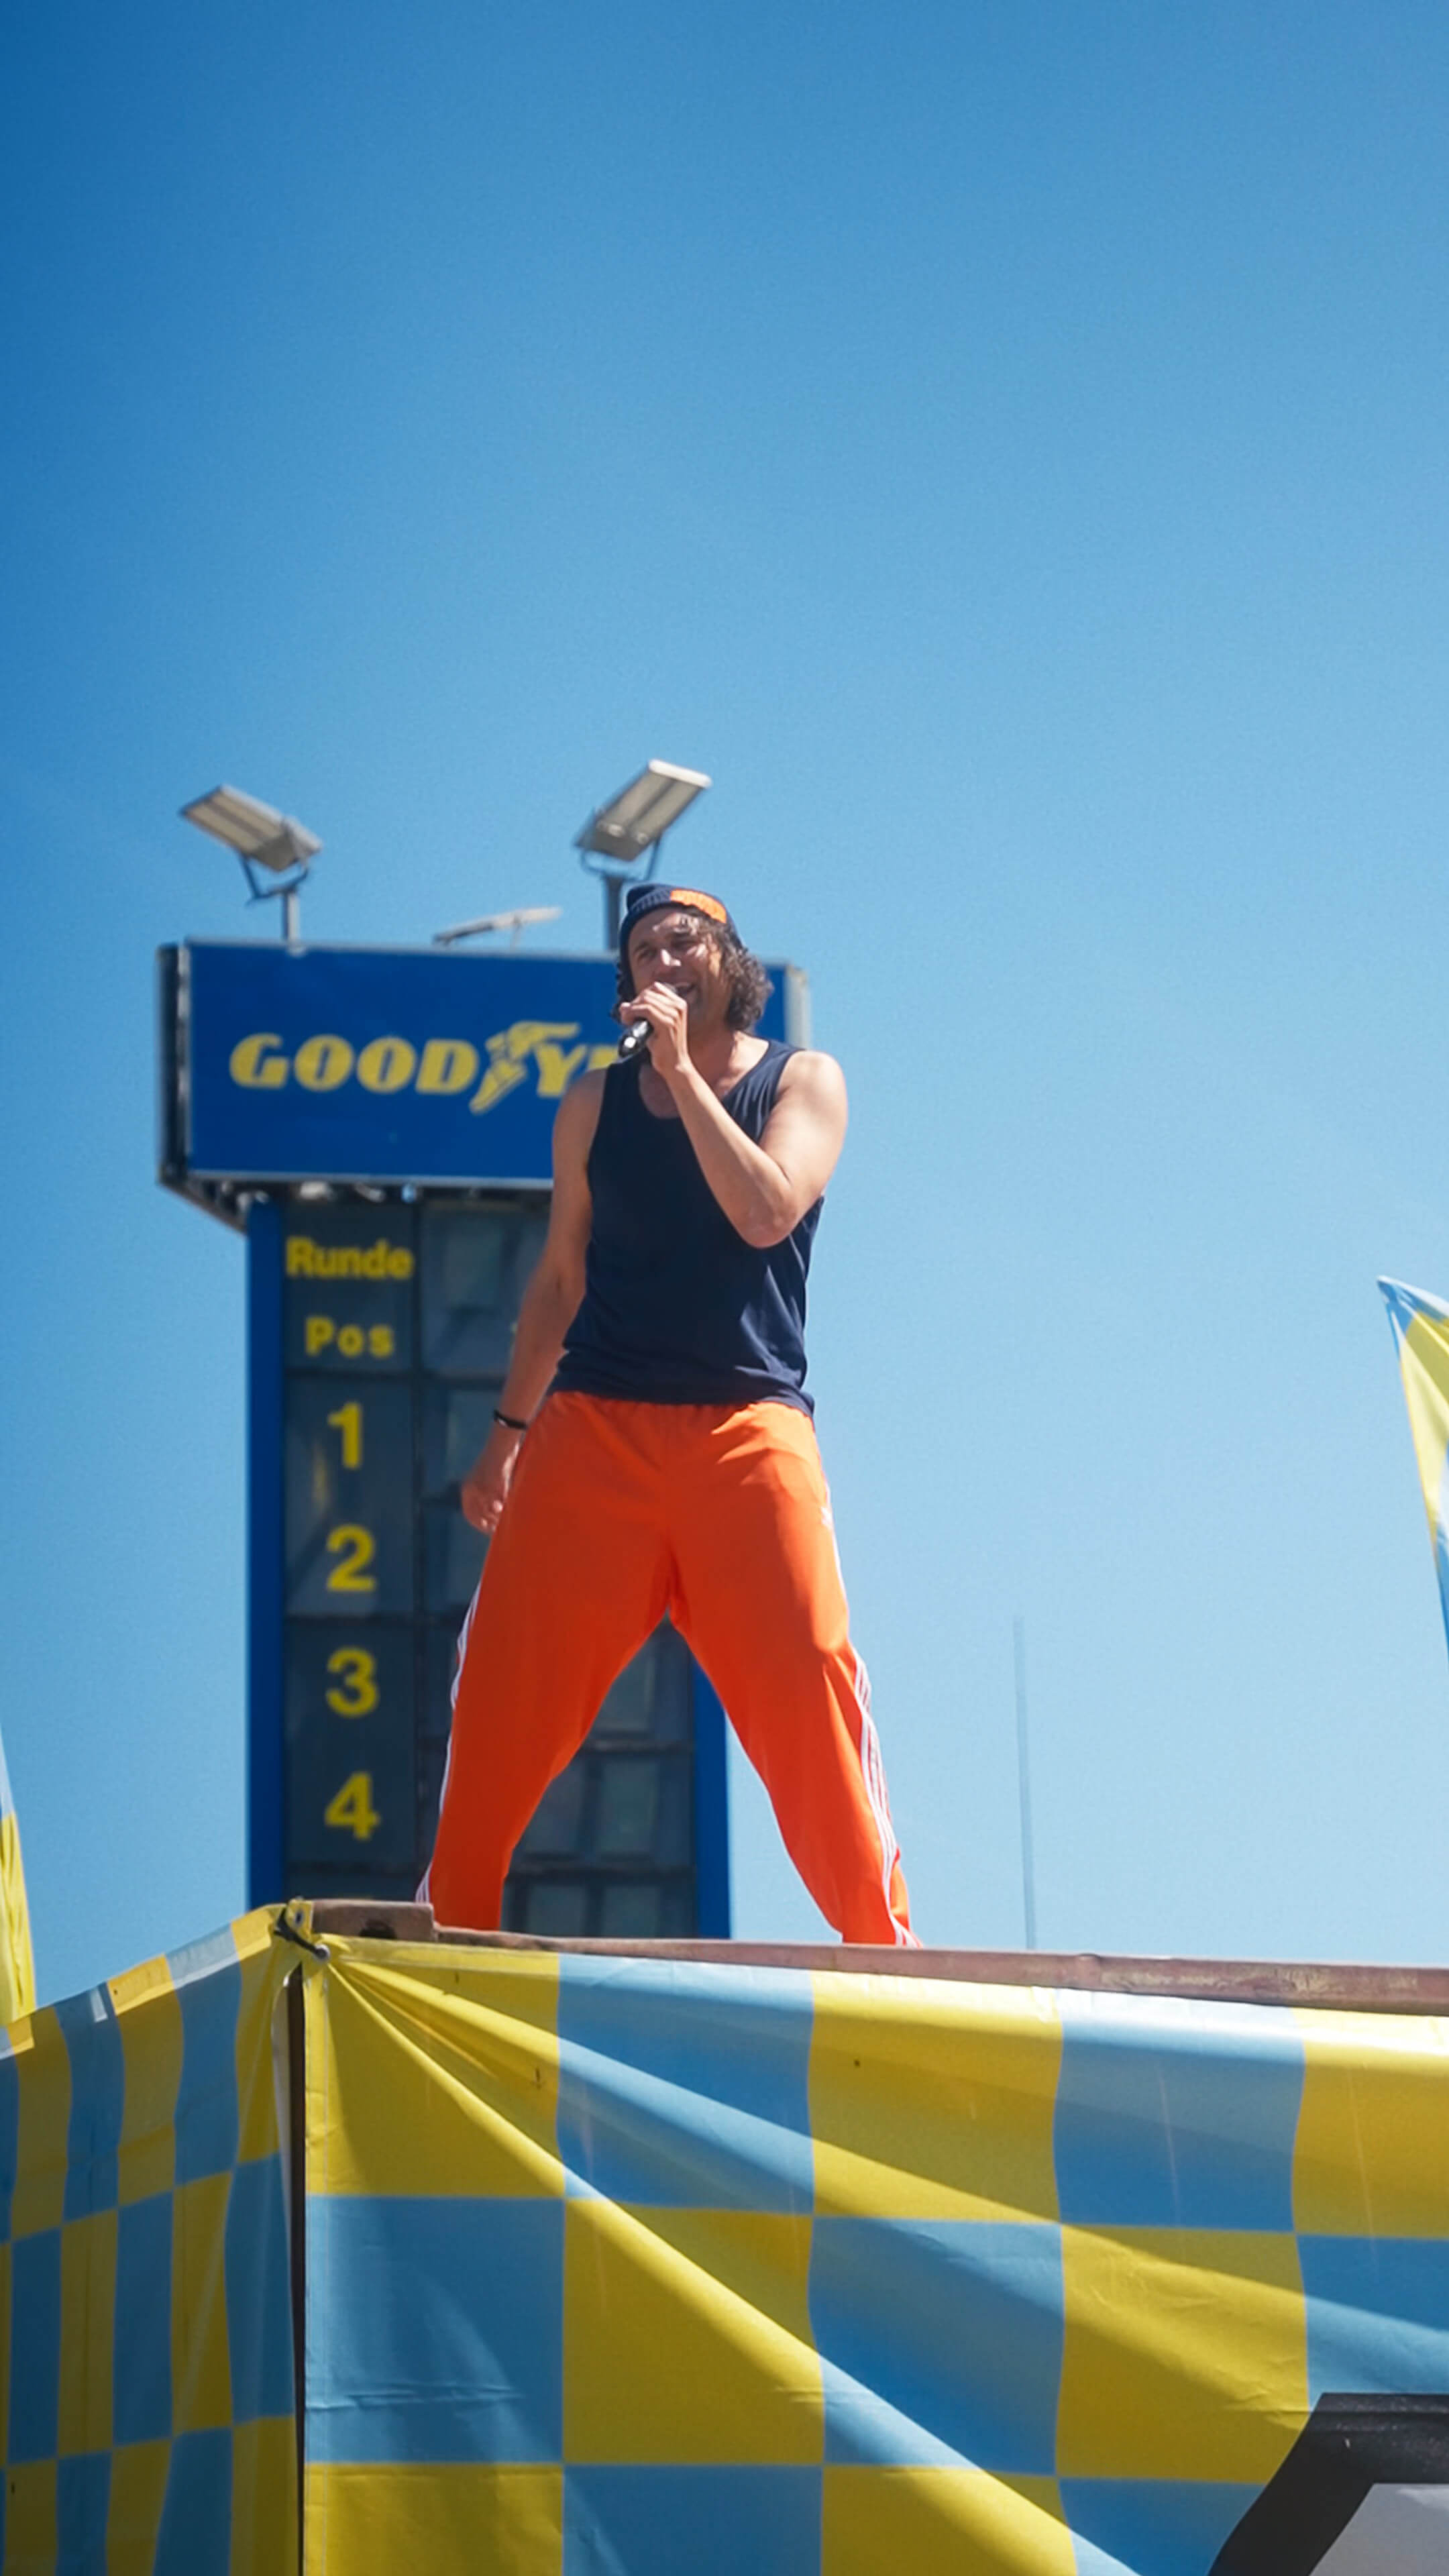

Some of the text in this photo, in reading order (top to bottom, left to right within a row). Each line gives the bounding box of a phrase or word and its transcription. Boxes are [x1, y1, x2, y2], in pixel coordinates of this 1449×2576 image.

[285, 1236, 415, 1281] Runde
[304, 1316, 394, 1358] Pos
[327, 1402, 363, 1469] 1
[325, 1523, 376, 1593] 2
[325, 1648, 378, 1717] 3
[323, 1772, 380, 1840] 4
